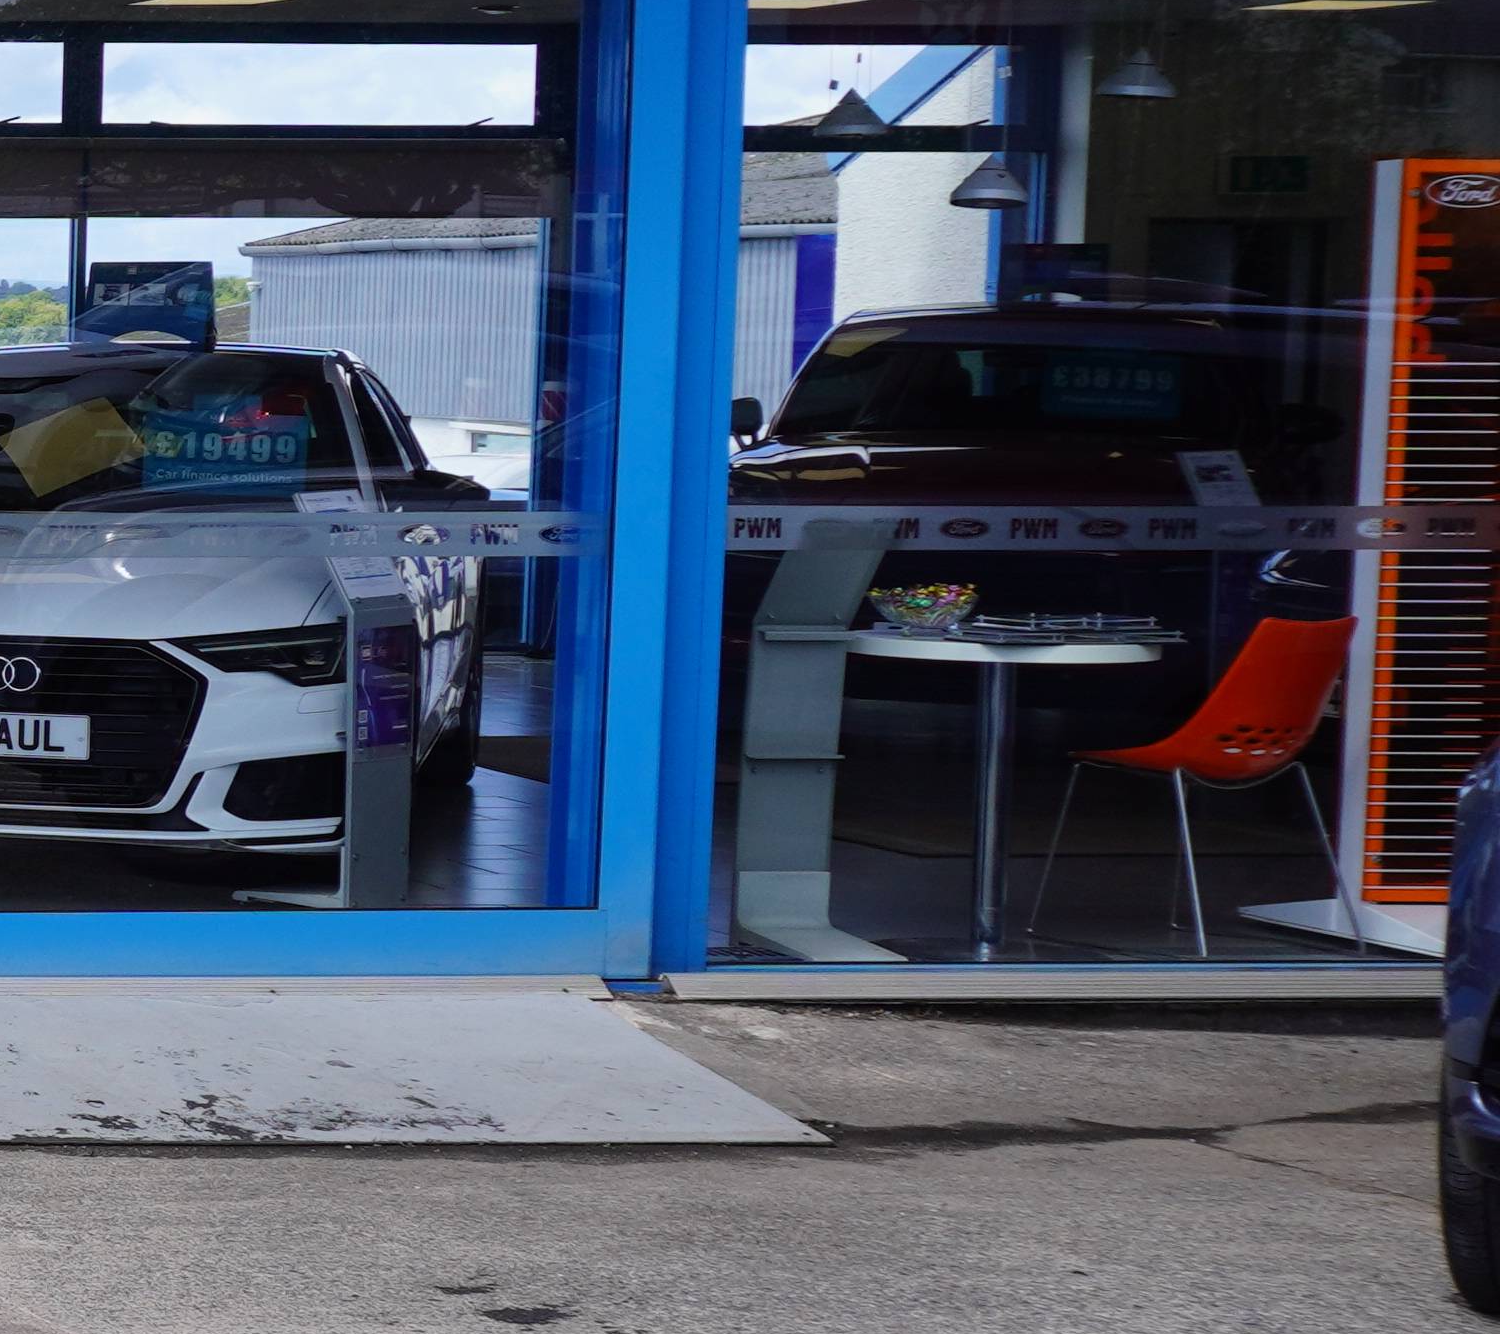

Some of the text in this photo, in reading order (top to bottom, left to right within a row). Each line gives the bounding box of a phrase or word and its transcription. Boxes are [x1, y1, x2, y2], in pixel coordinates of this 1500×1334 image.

[1440, 177, 1496, 204] Ford
[155, 430, 297, 463] £19499
[155, 468, 293, 484] Car finance solutions
[470, 523, 520, 545] PWM
[733, 518, 782, 539] PWM
[1009, 518, 1058, 539] PWM
[1147, 518, 1197, 539] PWM
